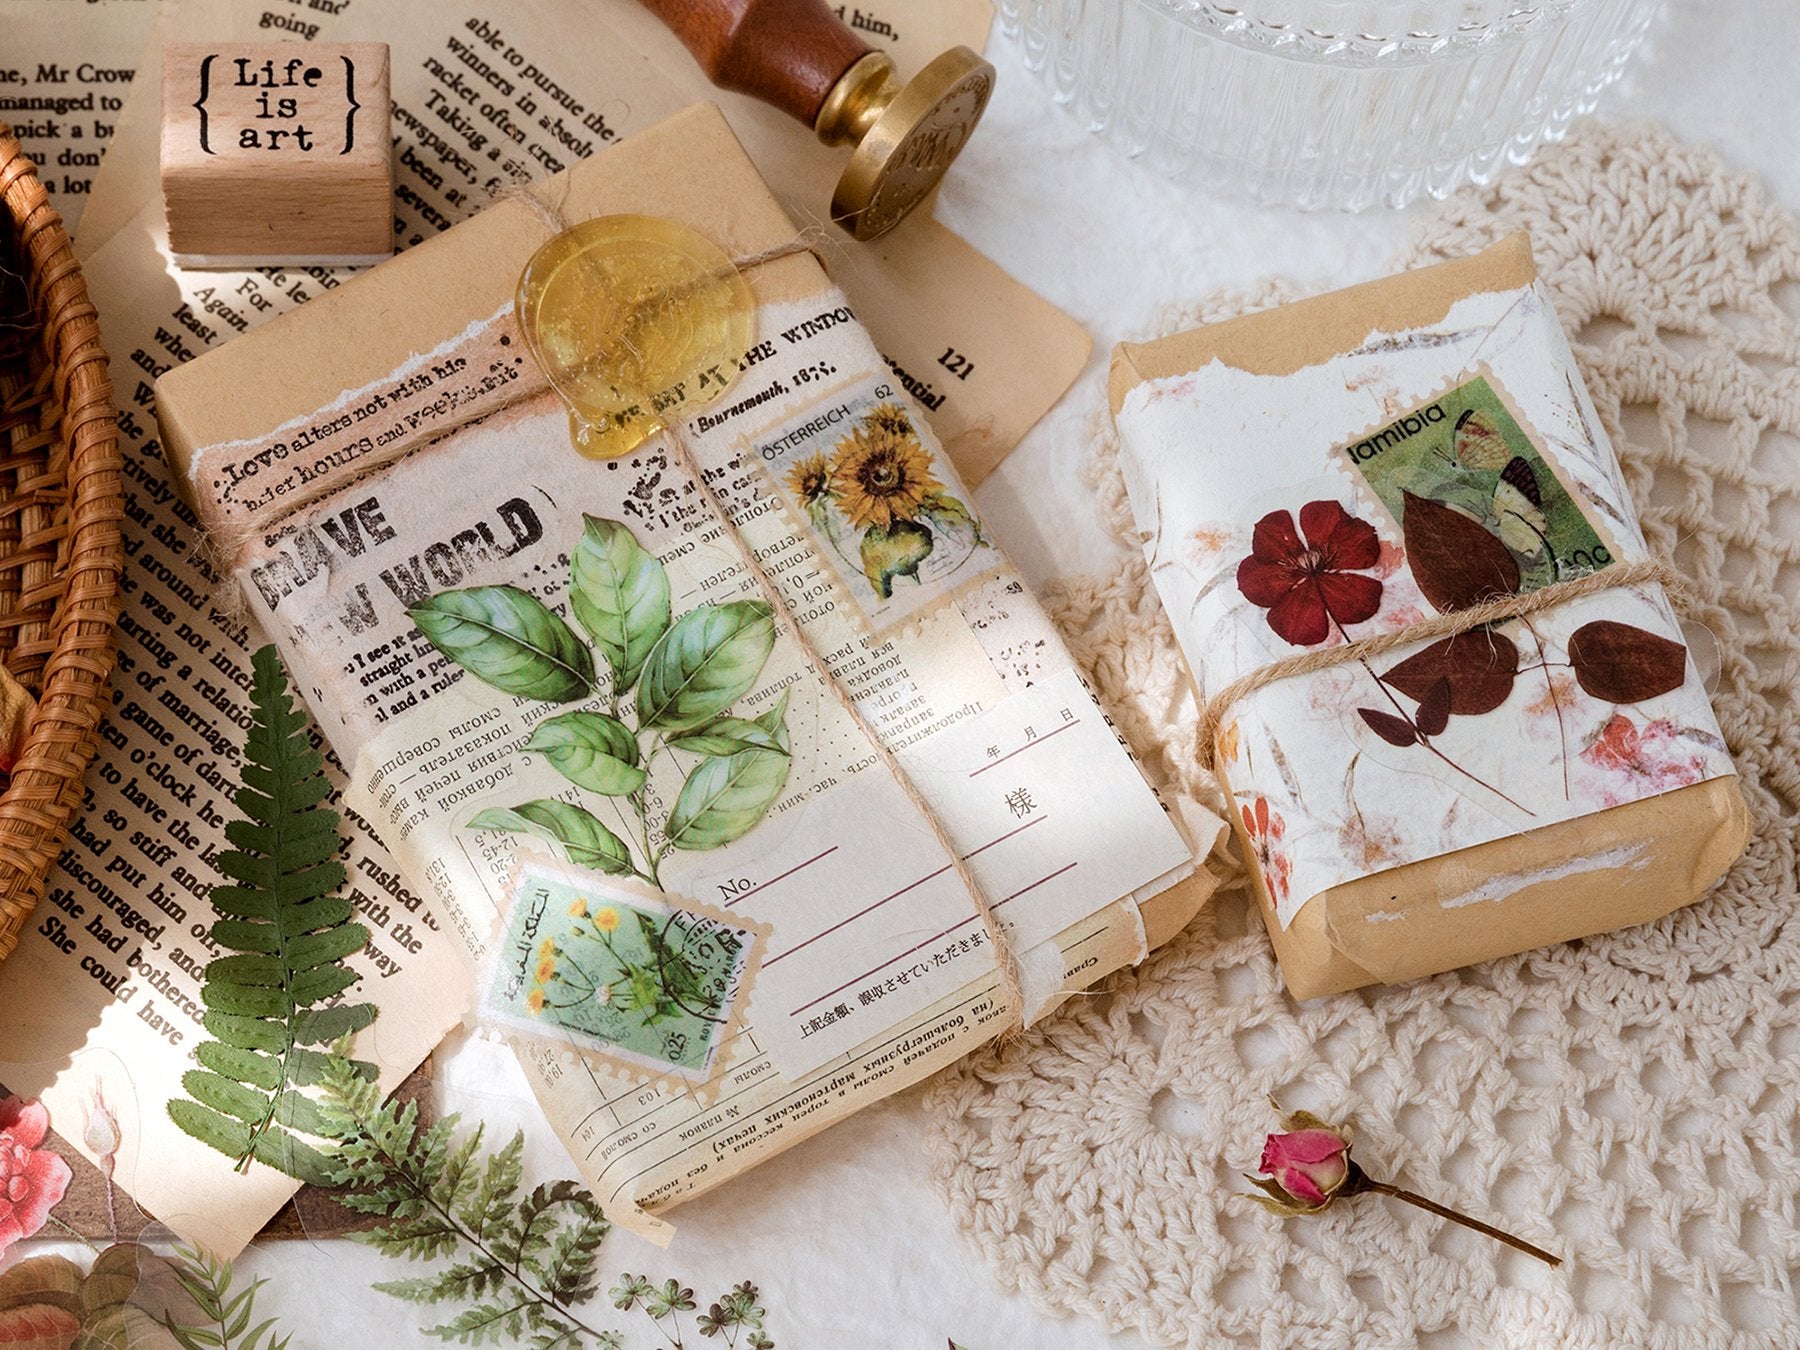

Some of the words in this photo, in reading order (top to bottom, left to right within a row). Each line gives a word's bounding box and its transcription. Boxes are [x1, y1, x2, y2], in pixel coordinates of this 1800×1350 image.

[258, 10, 320, 41] going
[851, 10, 899, 41] him,
[35, 64, 70, 83] Mr
[76, 64, 135, 83] Crow
[234, 57, 323, 88] Life
[446, 36, 514, 97] winners
[515, 92, 537, 117] in
[465, 15, 504, 51] able
[502, 48, 524, 68] to
[518, 64, 585, 116] pursue
[582, 113, 615, 141] the
[101, 95, 122, 111] to
[255, 91, 298, 119] is
[422, 55, 480, 107] racket
[479, 102, 526, 144] often
[13, 120, 60, 139] pick
[71, 126, 83, 139] a
[239, 125, 314, 151] art
[424, 88, 488, 151] Taking
[486, 148, 501, 162] a
[63, 176, 92, 194] lot
[400, 146, 443, 191] been
[235, 277, 274, 313] For
[171, 303, 218, 345] least
[937, 347, 974, 381] 121
[116, 410, 144, 440] he
[222, 441, 290, 484] Love
[292, 414, 353, 453] alters
[353, 394, 389, 423] not
[389, 372, 434, 405] with
[432, 357, 468, 382] his
[762, 403, 851, 461] ÖSTERREICH
[874, 384, 894, 400] 62
[291, 435, 375, 487] hours
[376, 422, 408, 449] and
[122, 491, 155, 530] hat
[151, 522, 187, 555] she
[138, 553, 209, 612] around
[139, 591, 177, 626] was
[174, 622, 212, 655] not
[366, 642, 392, 664] see
[871, 641, 895, 658] вся
[176, 665, 194, 682] a
[359, 650, 414, 687] straight
[379, 674, 416, 700] with
[415, 667, 428, 681] a
[847, 653, 903, 687] доводка
[389, 689, 419, 717] and
[418, 687, 430, 702] a
[430, 667, 466, 696] ruler
[740, 672, 803, 706] топлива,
[118, 701, 176, 748] game
[173, 743, 205, 767] of
[135, 669, 167, 693] of
[157, 689, 242, 768] marriage,
[449, 706, 502, 740] смолы
[986, 744, 1001, 759] 年
[1023, 725, 1037, 742] 月
[1059, 707, 1074, 722] 日
[366, 736, 442, 795] совершенно
[420, 722, 512, 775] показатель
[469, 729, 536, 774] ействия
[520, 755, 533, 767] с
[130, 747, 198, 808] o'clock
[196, 799, 225, 830] he
[413, 769, 462, 803] печей
[438, 762, 514, 814] добавкой
[98, 761, 123, 785] to
[119, 777, 169, 824] have
[166, 818, 201, 851] the
[103, 808, 128, 832] so
[128, 829, 178, 868] stiff
[170, 865, 213, 901] and
[482, 835, 519, 862] 12-45
[67, 816, 112, 858] had
[104, 854, 147, 890] put
[146, 881, 188, 924] him
[356, 856, 423, 913] rushed
[56, 848, 166, 951] discouraged,
[717, 875, 757, 902] No.
[49, 886, 85, 919] she
[85, 914, 128, 954] had
[349, 887, 391, 929] with
[390, 922, 424, 955] the
[362, 940, 404, 979] way
[38, 915, 77, 955] She
[80, 954, 138, 1004] could
[136, 999, 184, 1047] have
[970, 996, 995, 1017] (на
[862, 1014, 965, 1074] большегрузных
[962, 1024, 970, 1036] с
[902, 1032, 956, 1068] подачей
[733, 1059, 772, 1086] смолы
[852, 1065, 896, 1092] смолы
[637, 1087, 662, 1107] 103
[726, 1104, 741, 1119] №
[763, 1071, 856, 1125] мартеновских
[790, 1097, 831, 1123] торец
[641, 1121, 657, 1134] со
[678, 1113, 724, 1142] плавок
[711, 1123, 757, 1155] печах)
[733, 1123, 785, 1154] кессона
[686, 1162, 709, 1179] без
